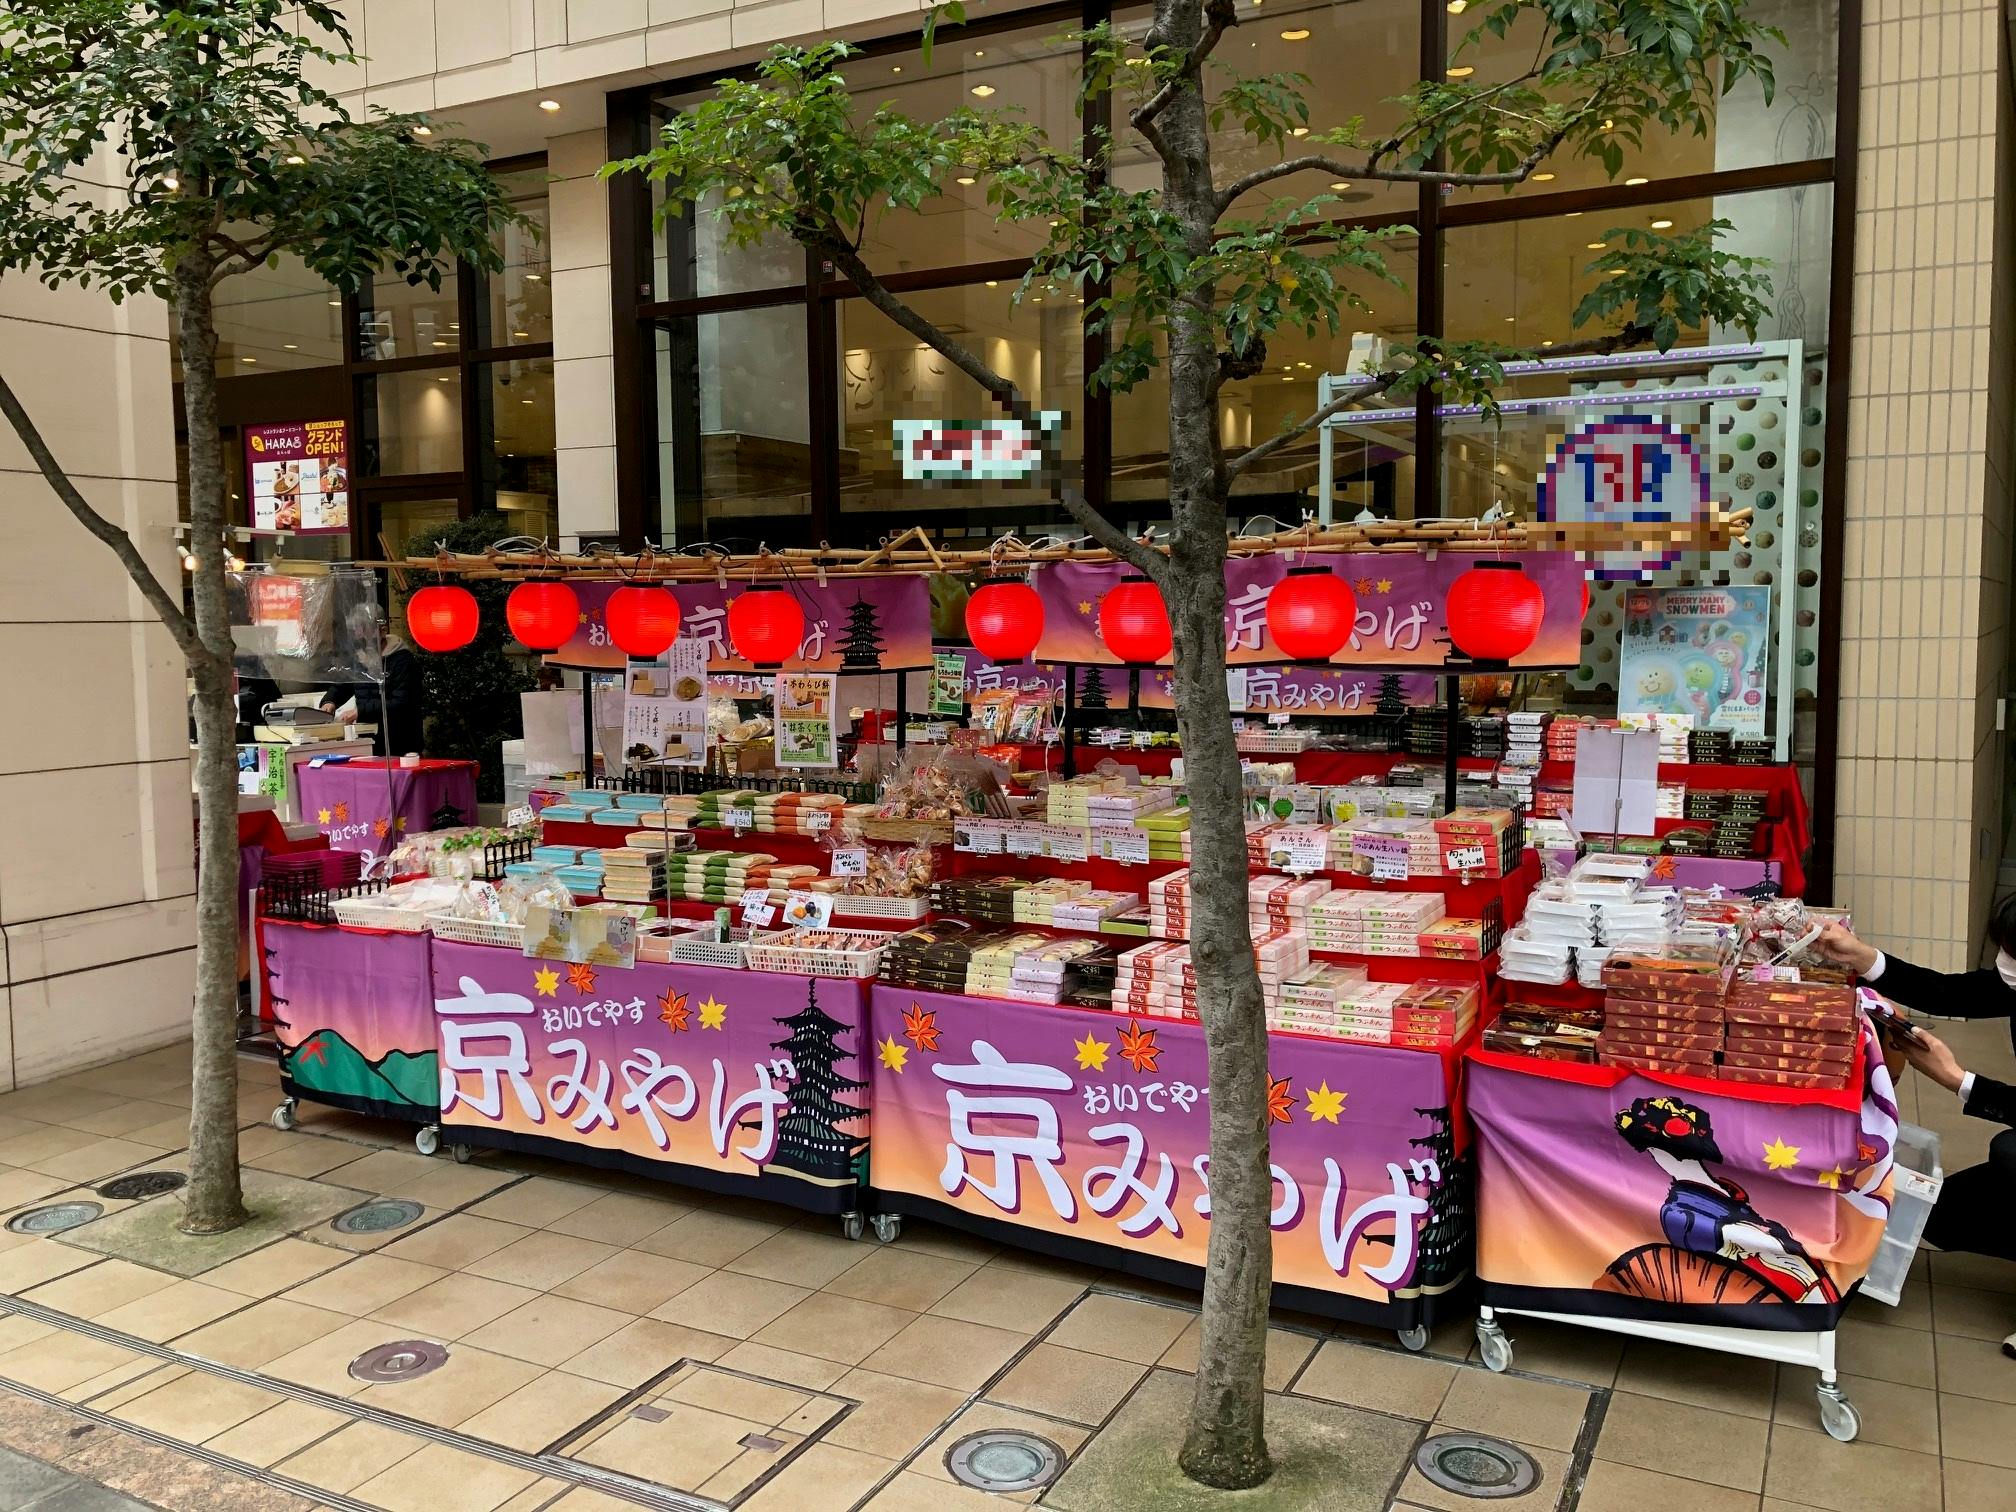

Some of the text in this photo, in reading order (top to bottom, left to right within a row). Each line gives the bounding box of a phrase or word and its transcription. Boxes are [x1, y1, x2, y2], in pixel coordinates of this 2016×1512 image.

[305, 441, 344, 456] OPEN!
[307, 428, 343, 443] グランド
[1665, 604, 1726, 615] SNOWMEN
[1247, 668, 1366, 710] 京みやげ
[268, 748, 279, 796] 宇治茶
[1354, 843, 1408, 855] つぶあん生八ッ橋
[542, 996, 647, 1033] おいでやす
[434, 975, 798, 1160] 京みやげ
[1083, 1081, 1209, 1114] おいでや
